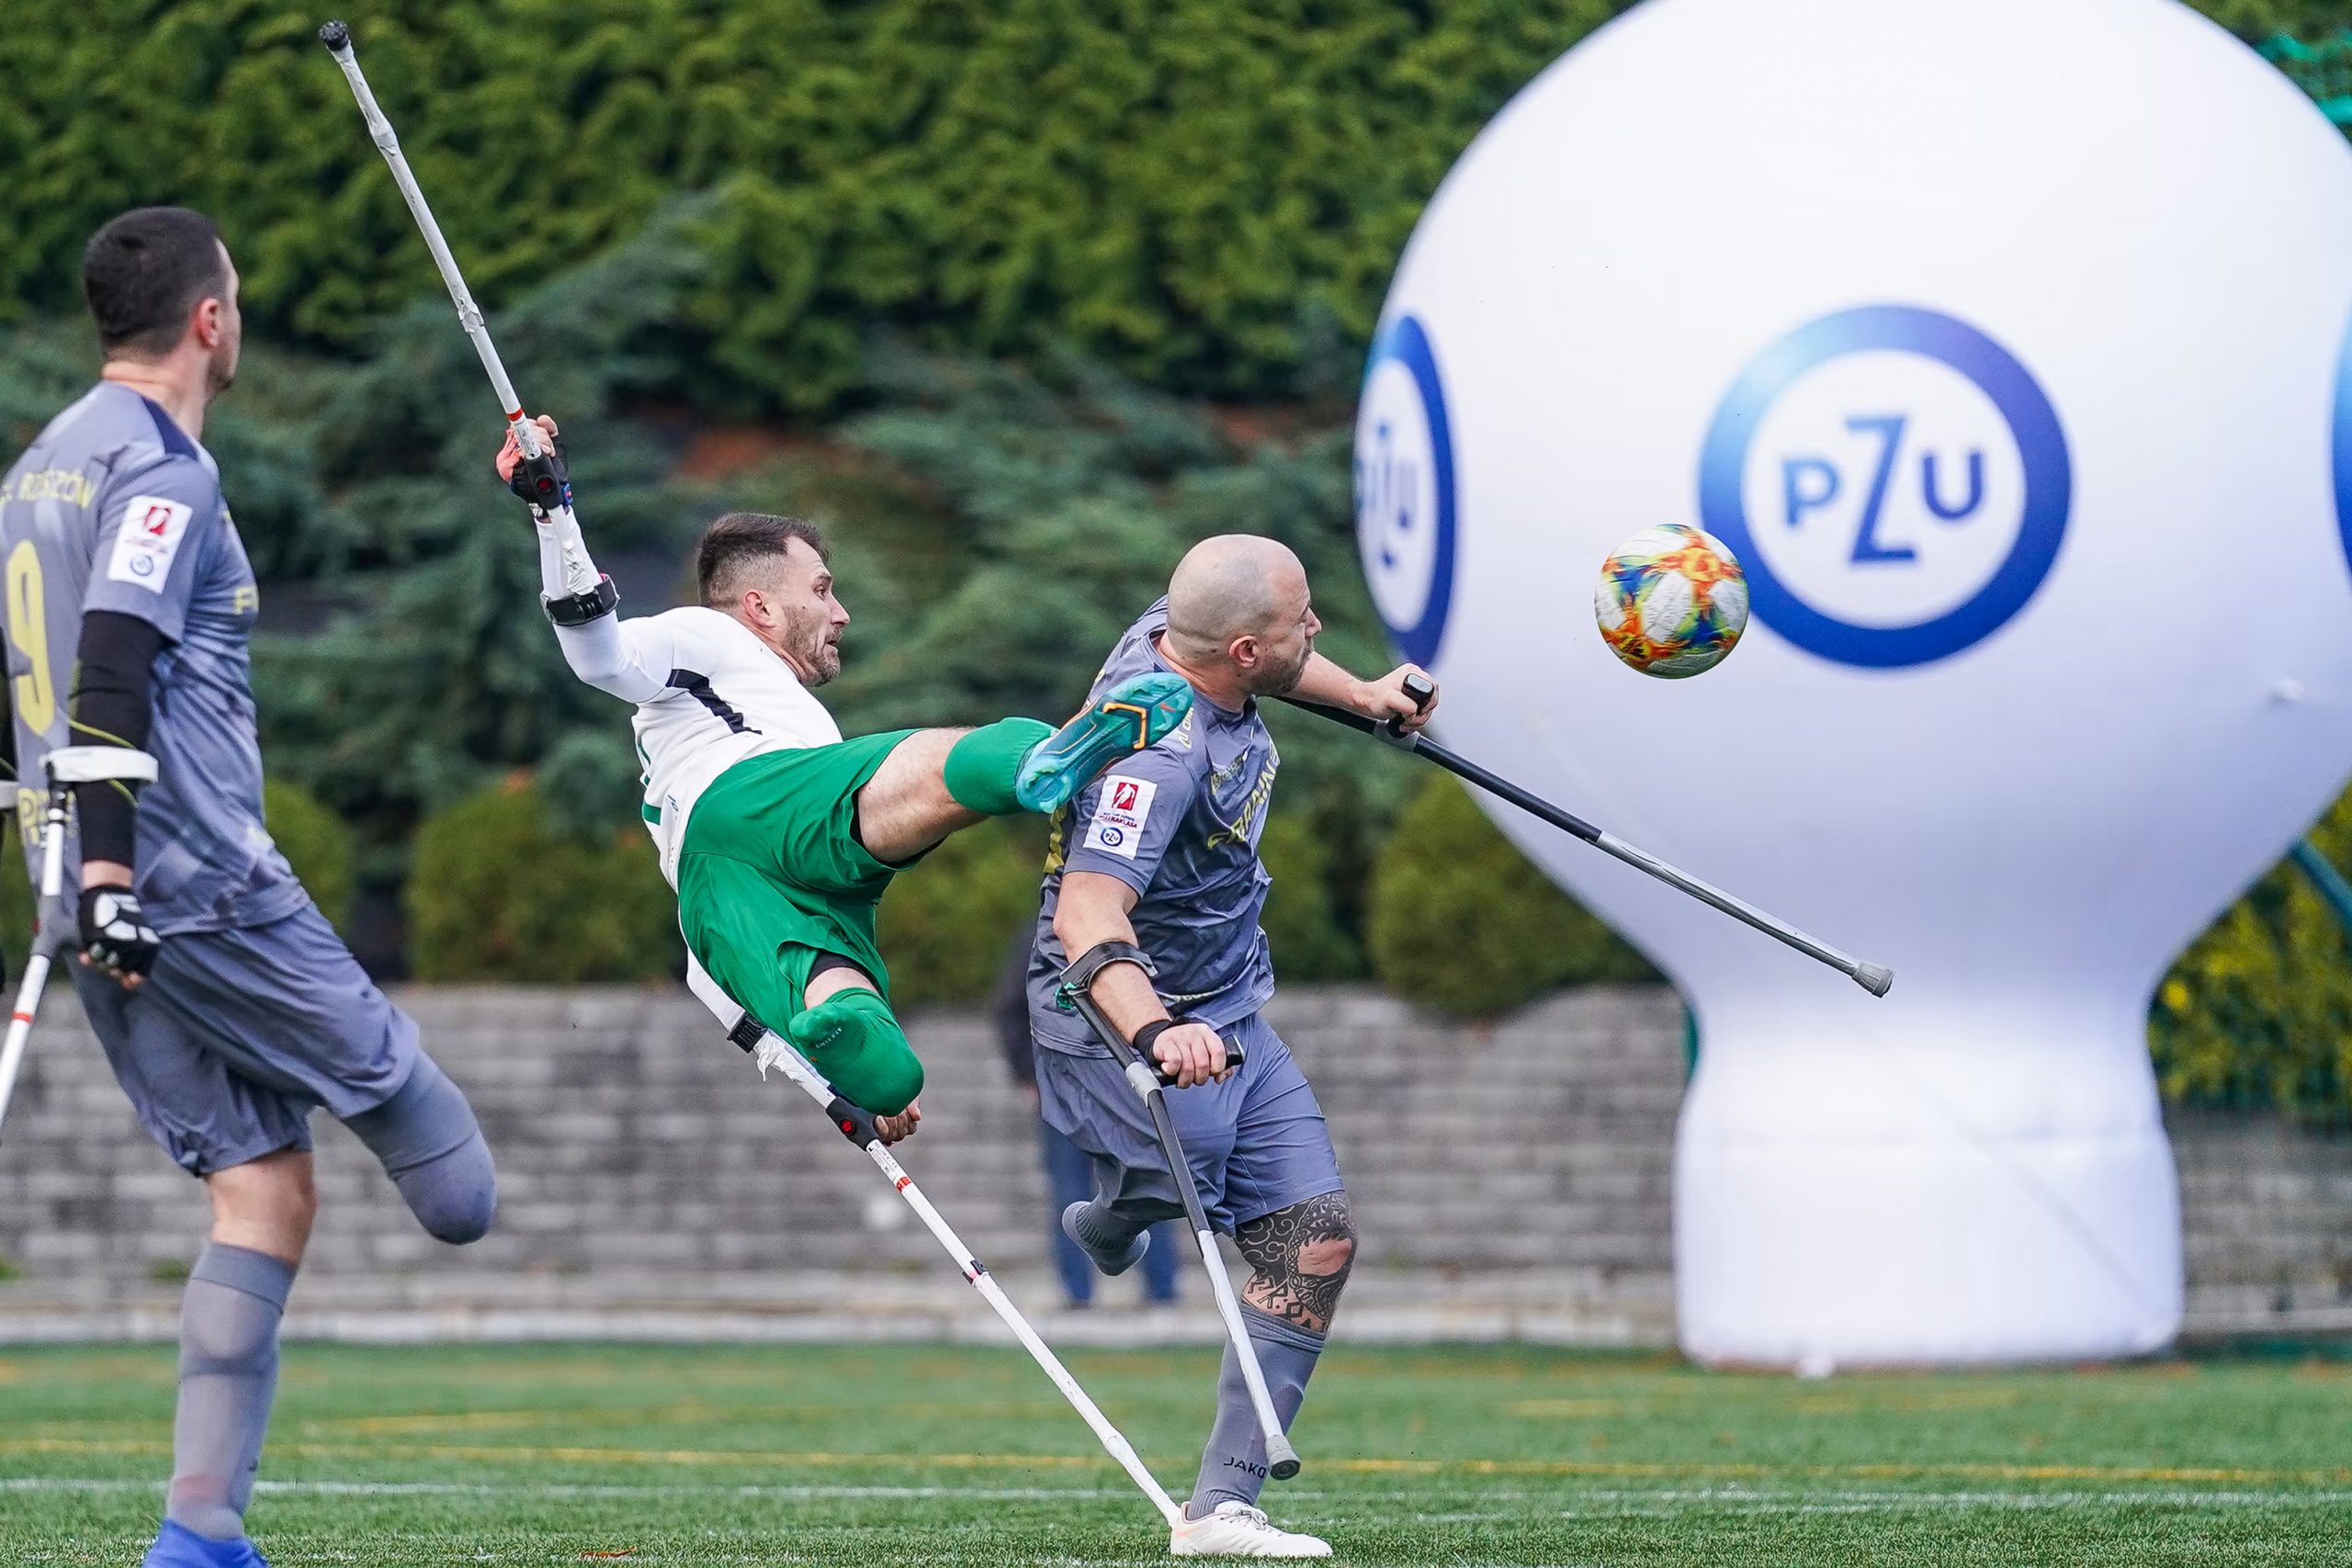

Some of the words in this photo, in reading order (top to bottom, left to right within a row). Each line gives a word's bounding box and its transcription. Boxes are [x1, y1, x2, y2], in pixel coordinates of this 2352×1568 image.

[1780, 415, 1987, 564] PZU
[6, 538, 54, 737] 9
[1223, 1456, 1267, 1479] JAKO
